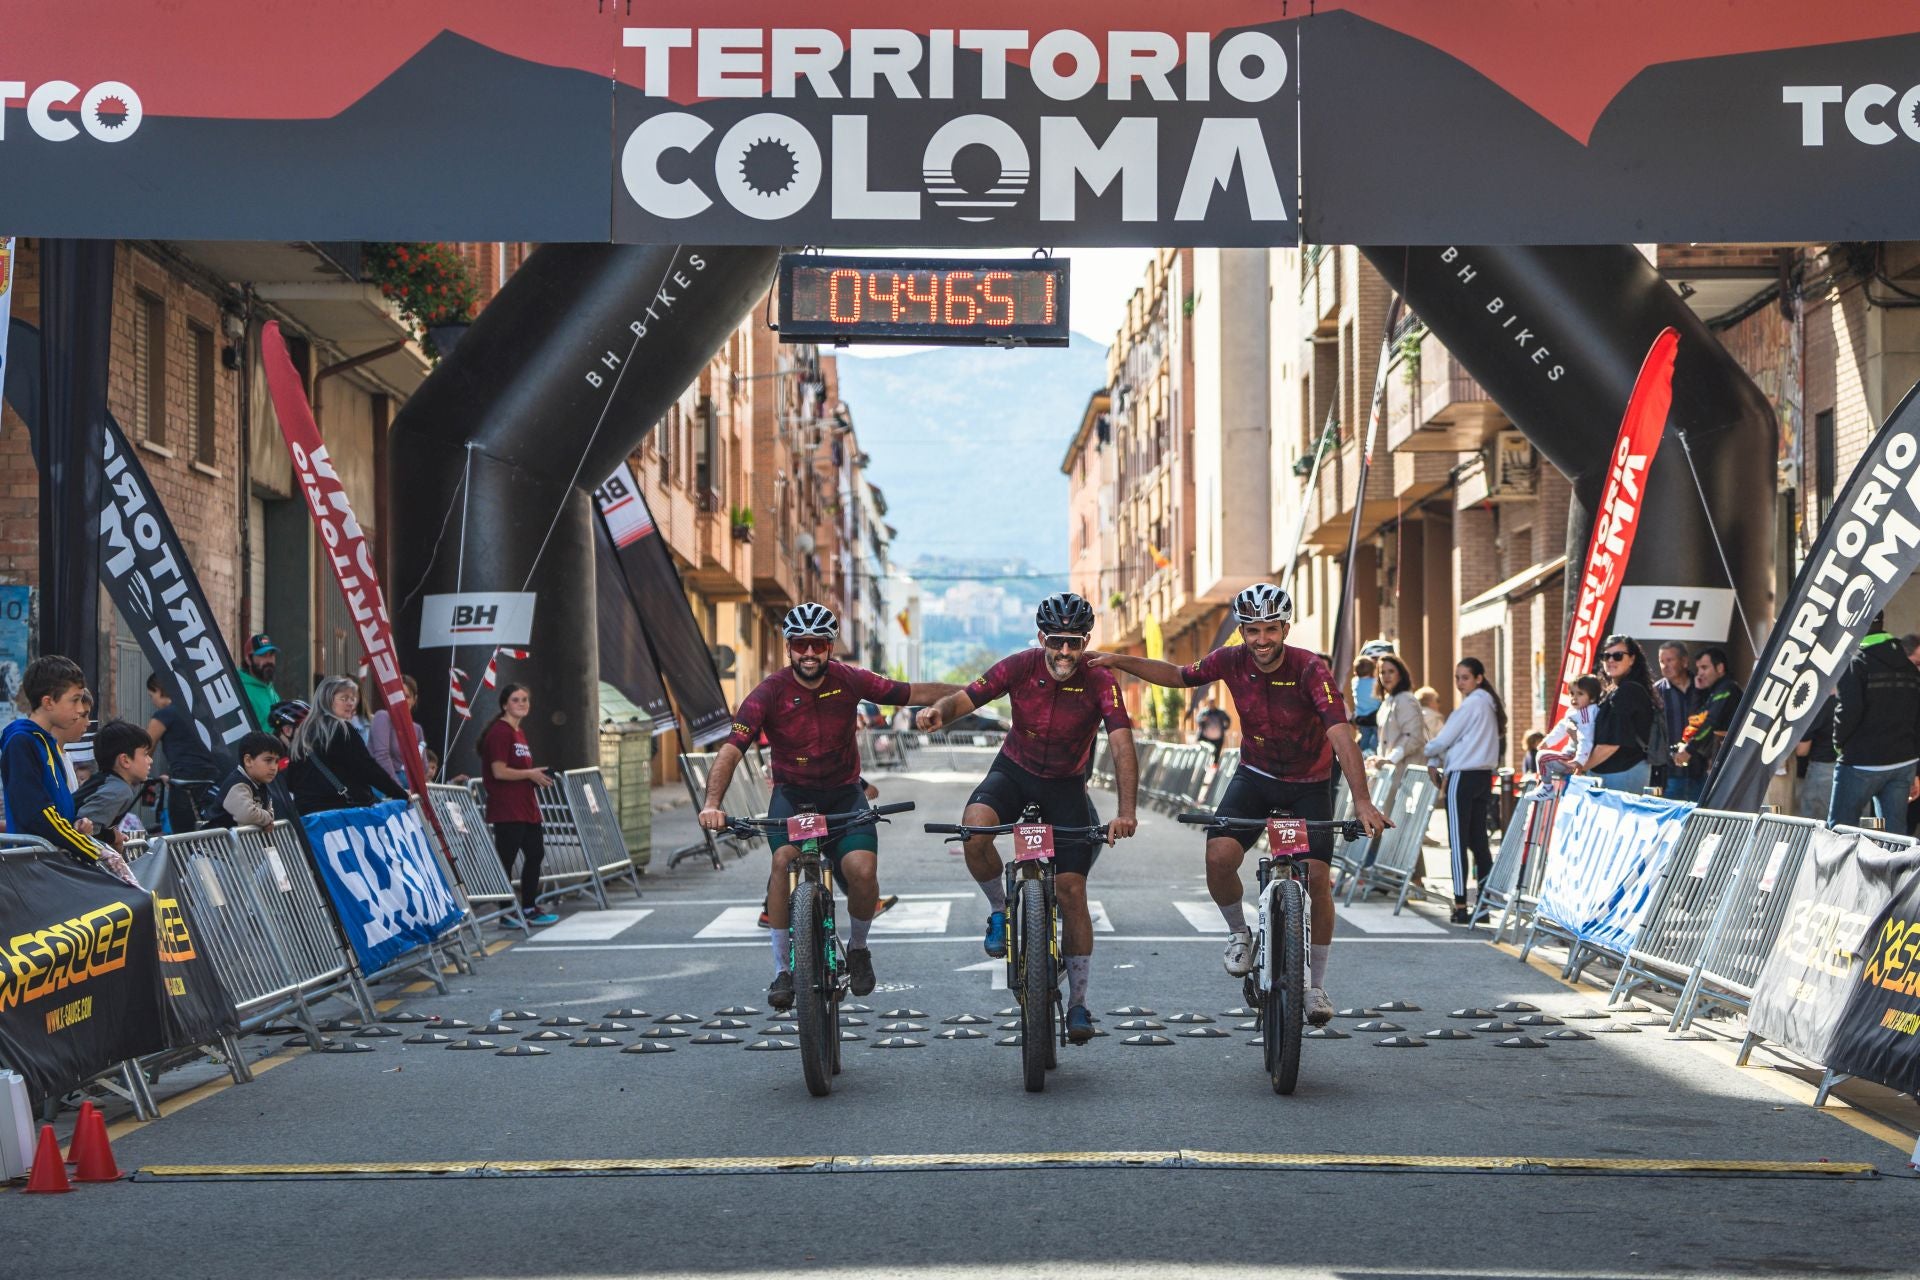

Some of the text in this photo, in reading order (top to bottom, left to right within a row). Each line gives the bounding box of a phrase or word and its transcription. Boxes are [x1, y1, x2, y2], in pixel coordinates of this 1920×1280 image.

[622, 28, 1288, 103] TERRITORIO
[621, 111, 1288, 223] COLOMA
[584, 254, 707, 388] BH BIKES
[1440, 246, 1565, 381] BH BIKES
[451, 604, 499, 626] BH
[1651, 599, 1701, 621] BH
[1734, 432, 1918, 748] TERRITORIO
[1761, 464, 1920, 765] COLOM
[798, 816, 815, 826] 72
[1025, 835, 1042, 846] 70
[1279, 829, 1296, 840] 79
